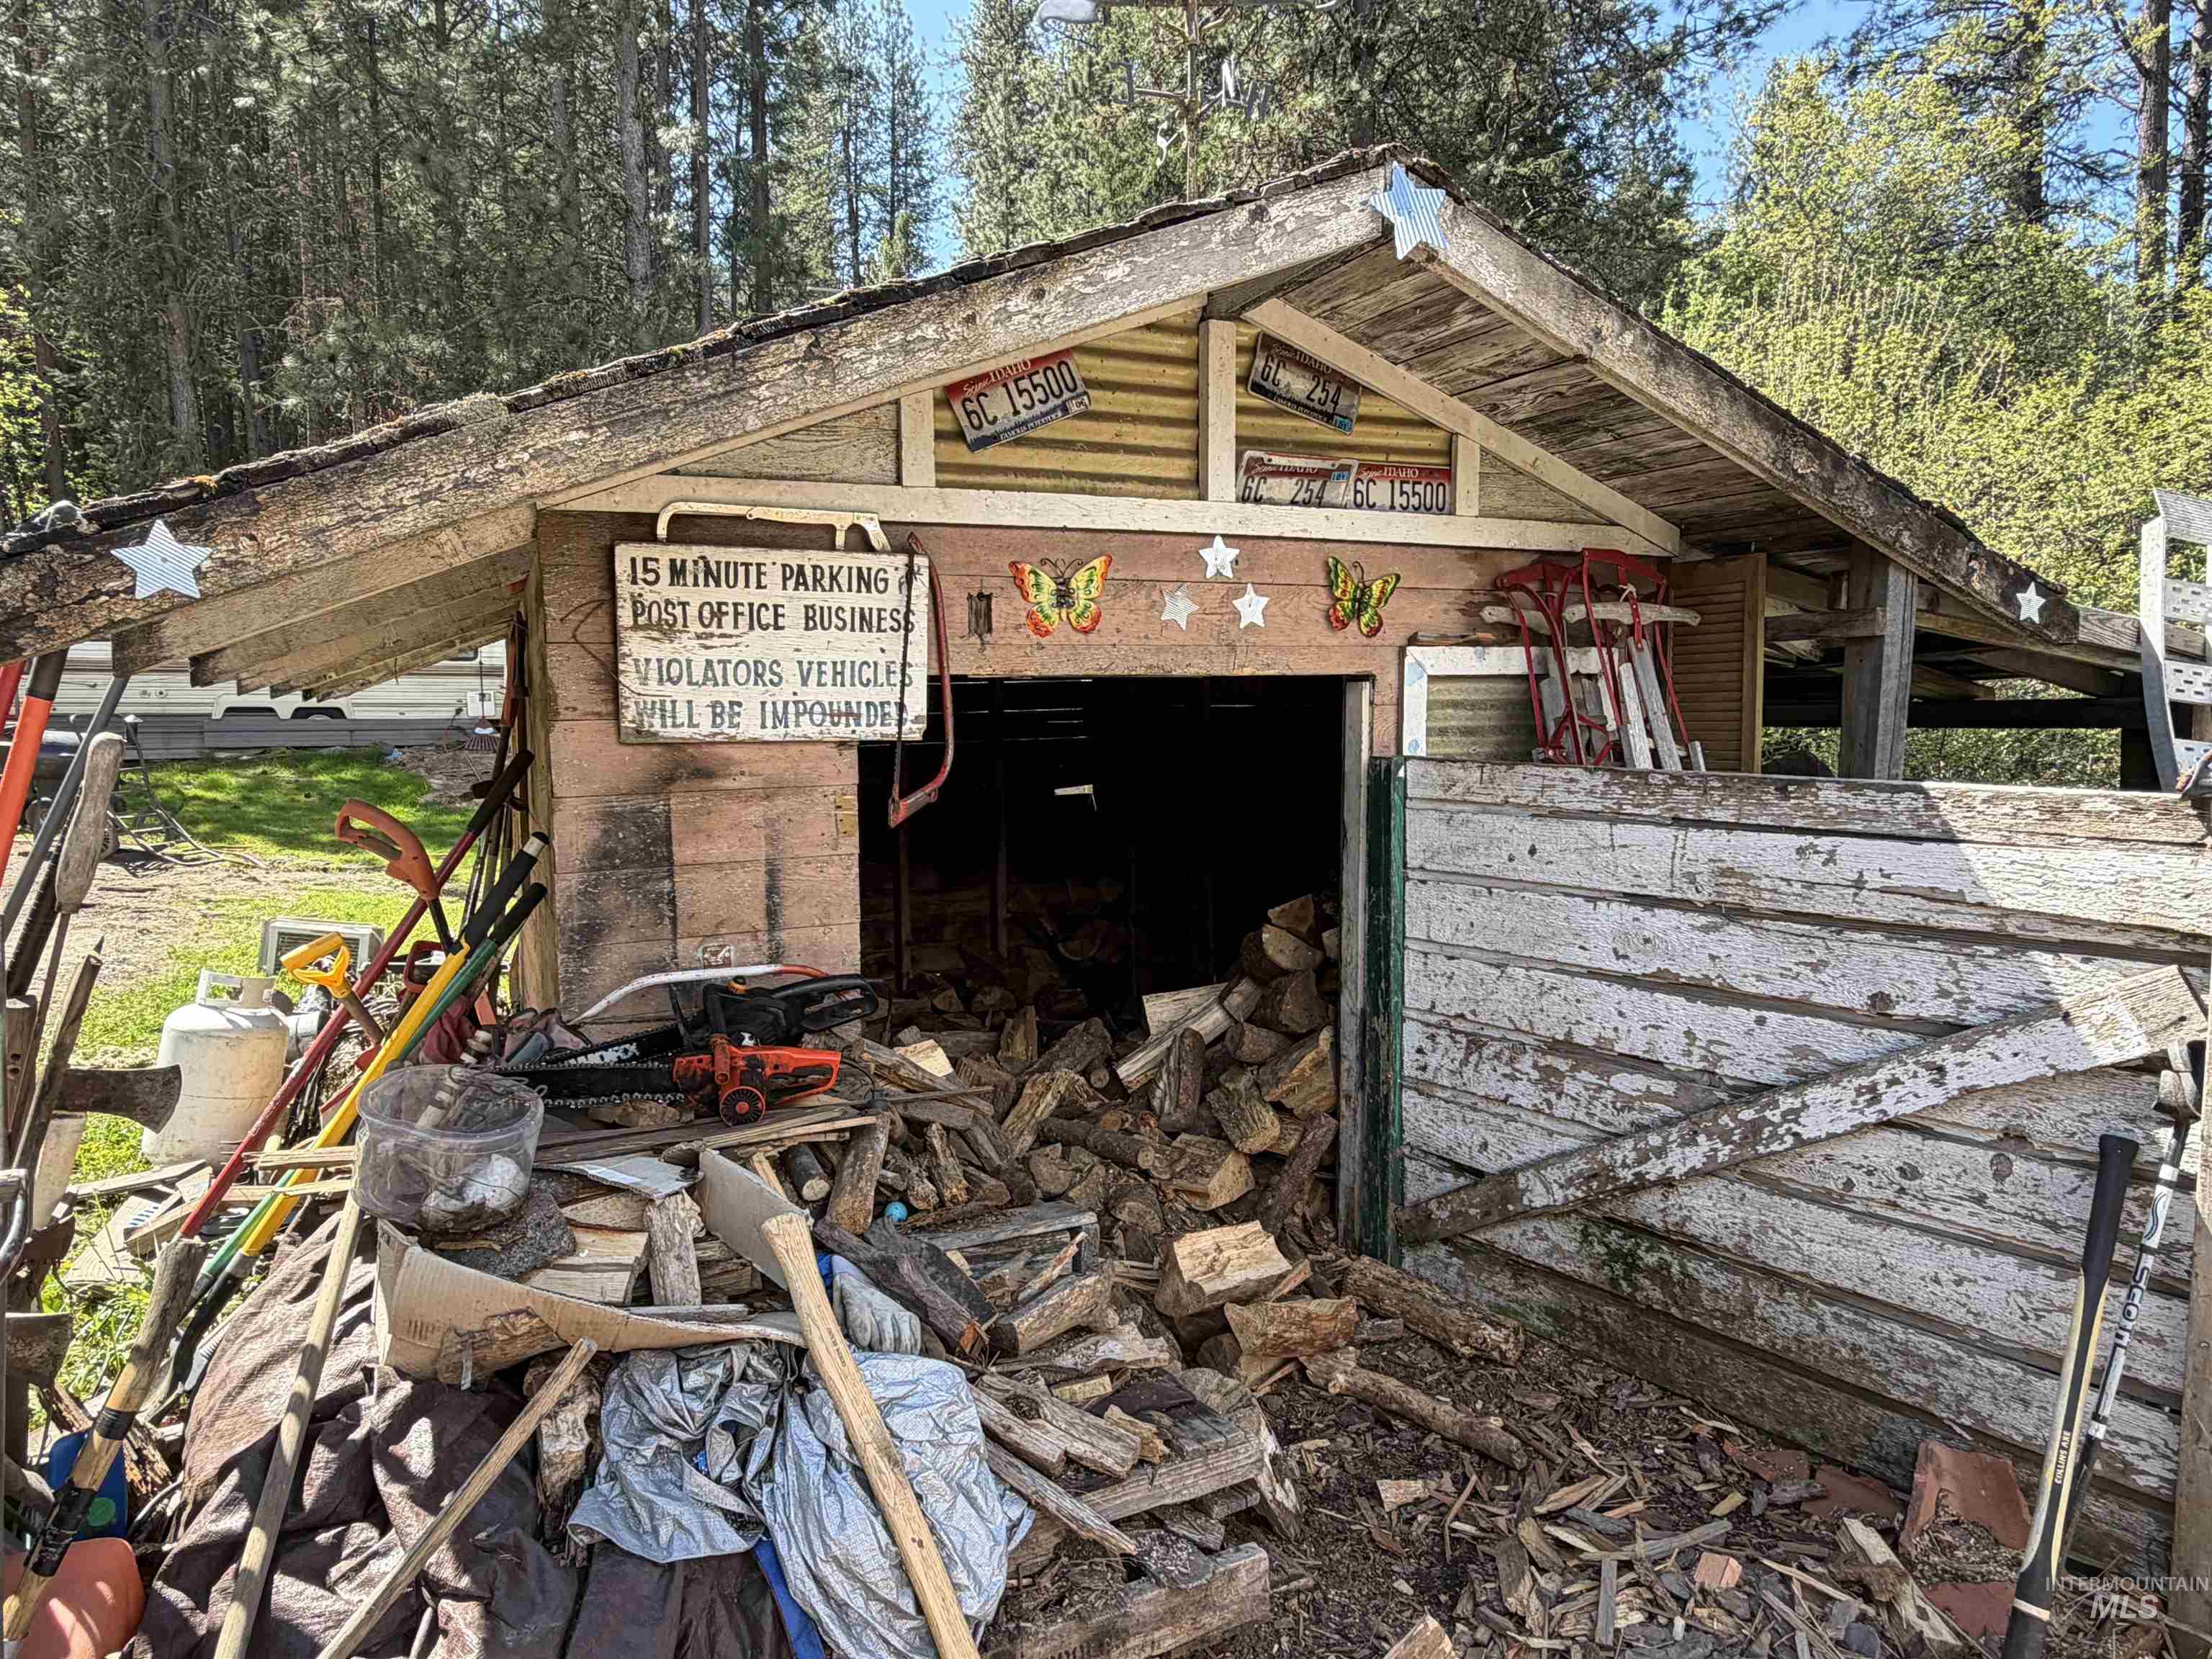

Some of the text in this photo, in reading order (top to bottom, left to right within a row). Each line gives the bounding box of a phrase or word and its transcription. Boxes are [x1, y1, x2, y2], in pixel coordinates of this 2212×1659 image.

[989, 360, 1032, 382] IDAHO
[1295, 351, 1332, 374] IDAHO
[961, 360, 1078, 431] 6C 15500
[1261, 354, 1287, 387] 6C
[1305, 374, 1342, 413] 254
[1382, 467, 1419, 478] IDAHO
[1241, 475, 1328, 508] 6C 254
[1354, 477, 1446, 512] 6C 15500
[629, 556, 661, 586] 15
[668, 557, 768, 590] MINUTE
[781, 562, 889, 594] PARKING
[632, 600, 915, 633] POST OFFICE BUSINESS
[634, 657, 913, 688] VIOLATORS VEHICLES
[634, 698, 909, 729] WILL BE IMPOUNDED
[2054, 1430, 2072, 1484] COLLINS AXE
